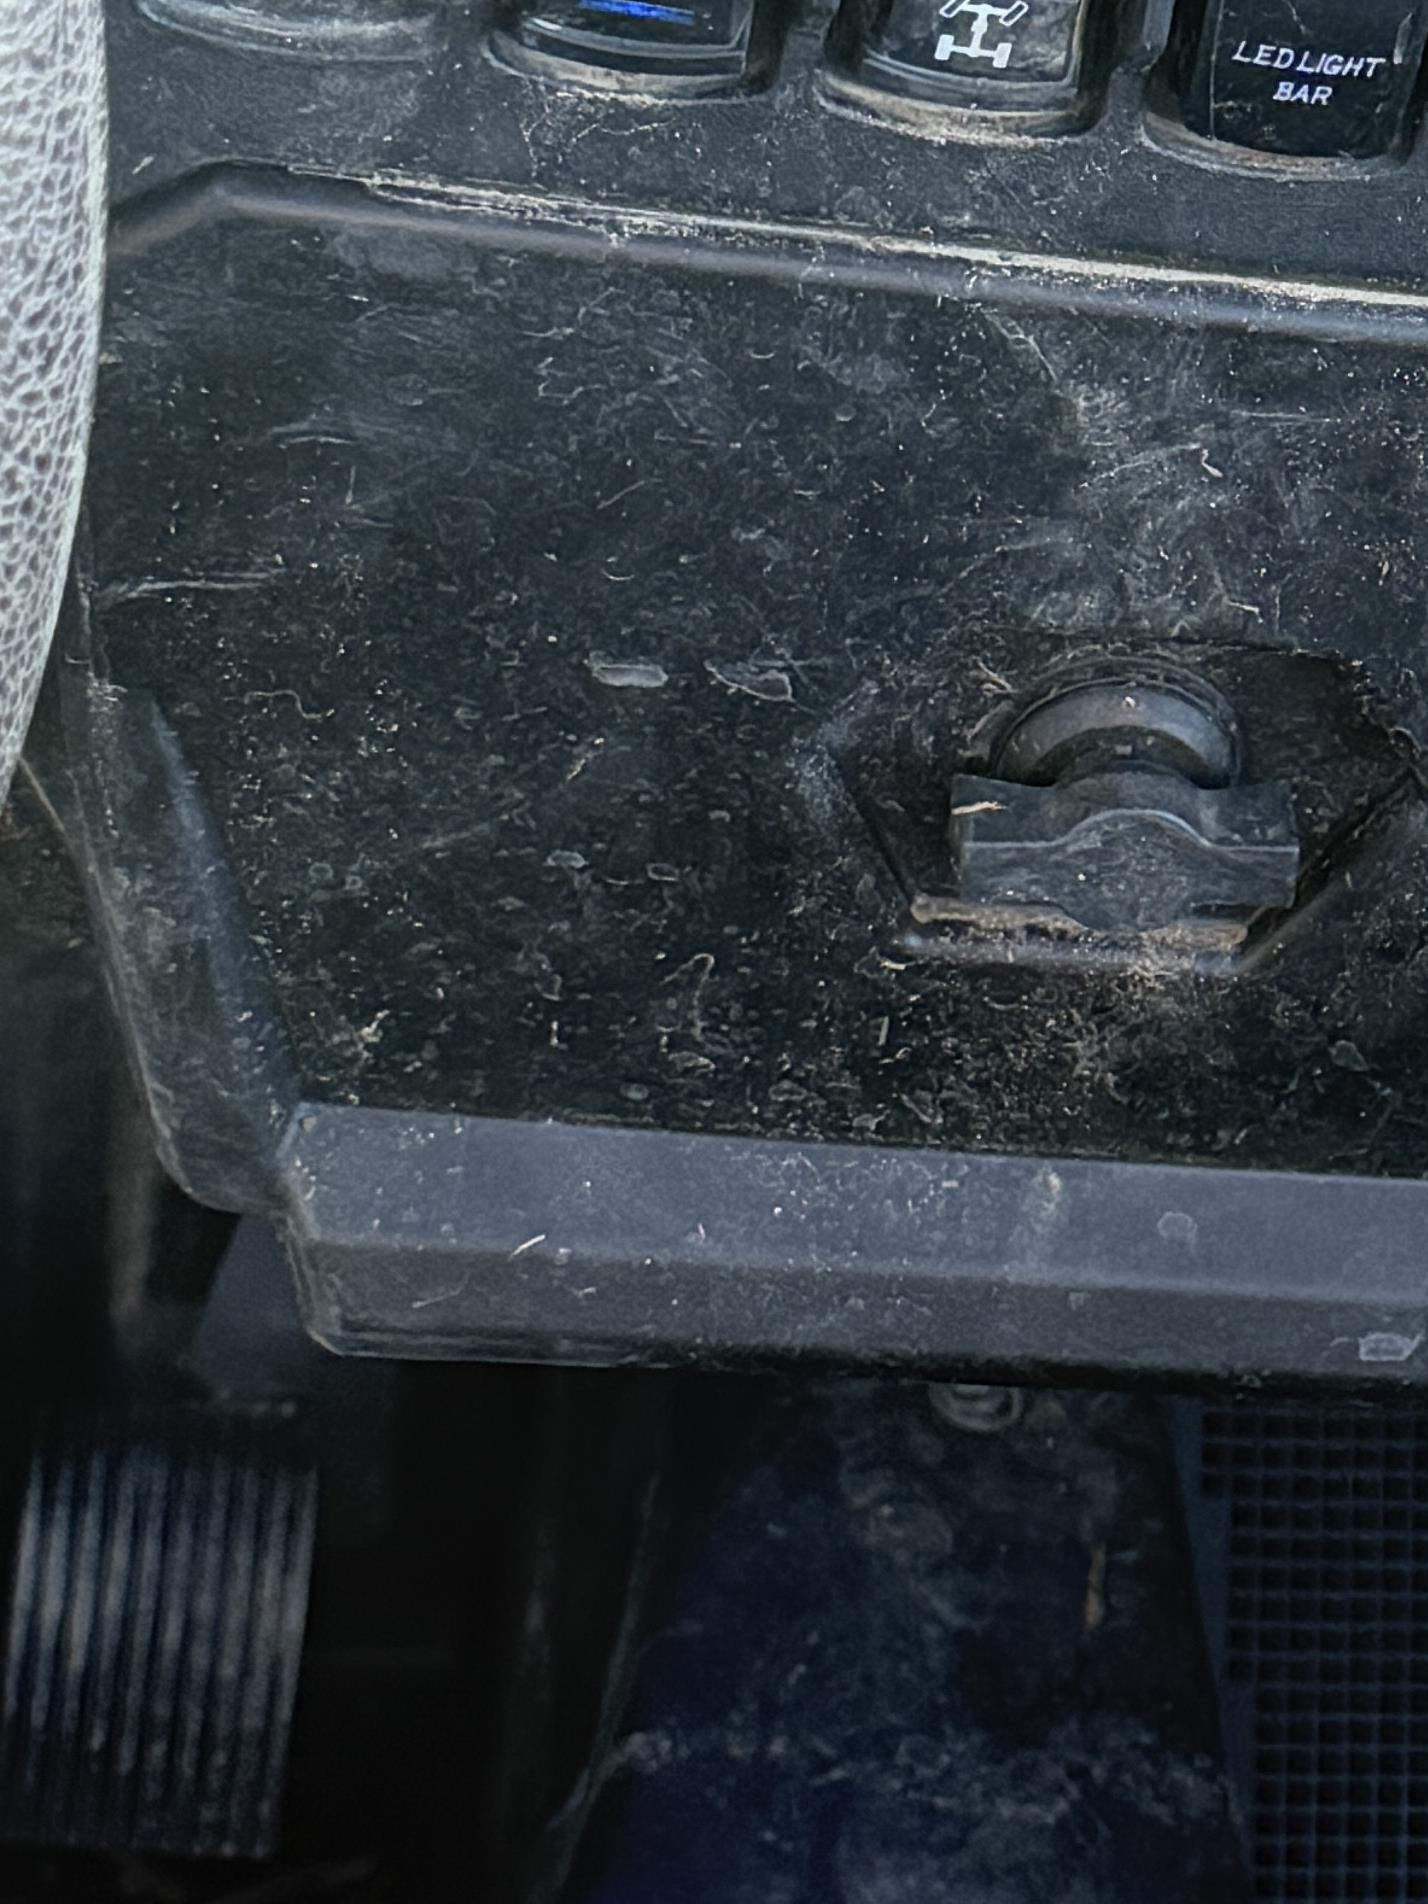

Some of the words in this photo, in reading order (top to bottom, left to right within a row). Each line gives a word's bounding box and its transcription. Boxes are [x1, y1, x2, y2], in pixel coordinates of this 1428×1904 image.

[1232, 40, 1295, 69] LED
[1296, 50, 1386, 77] LIGHT
[1272, 81, 1333, 106] BAR
